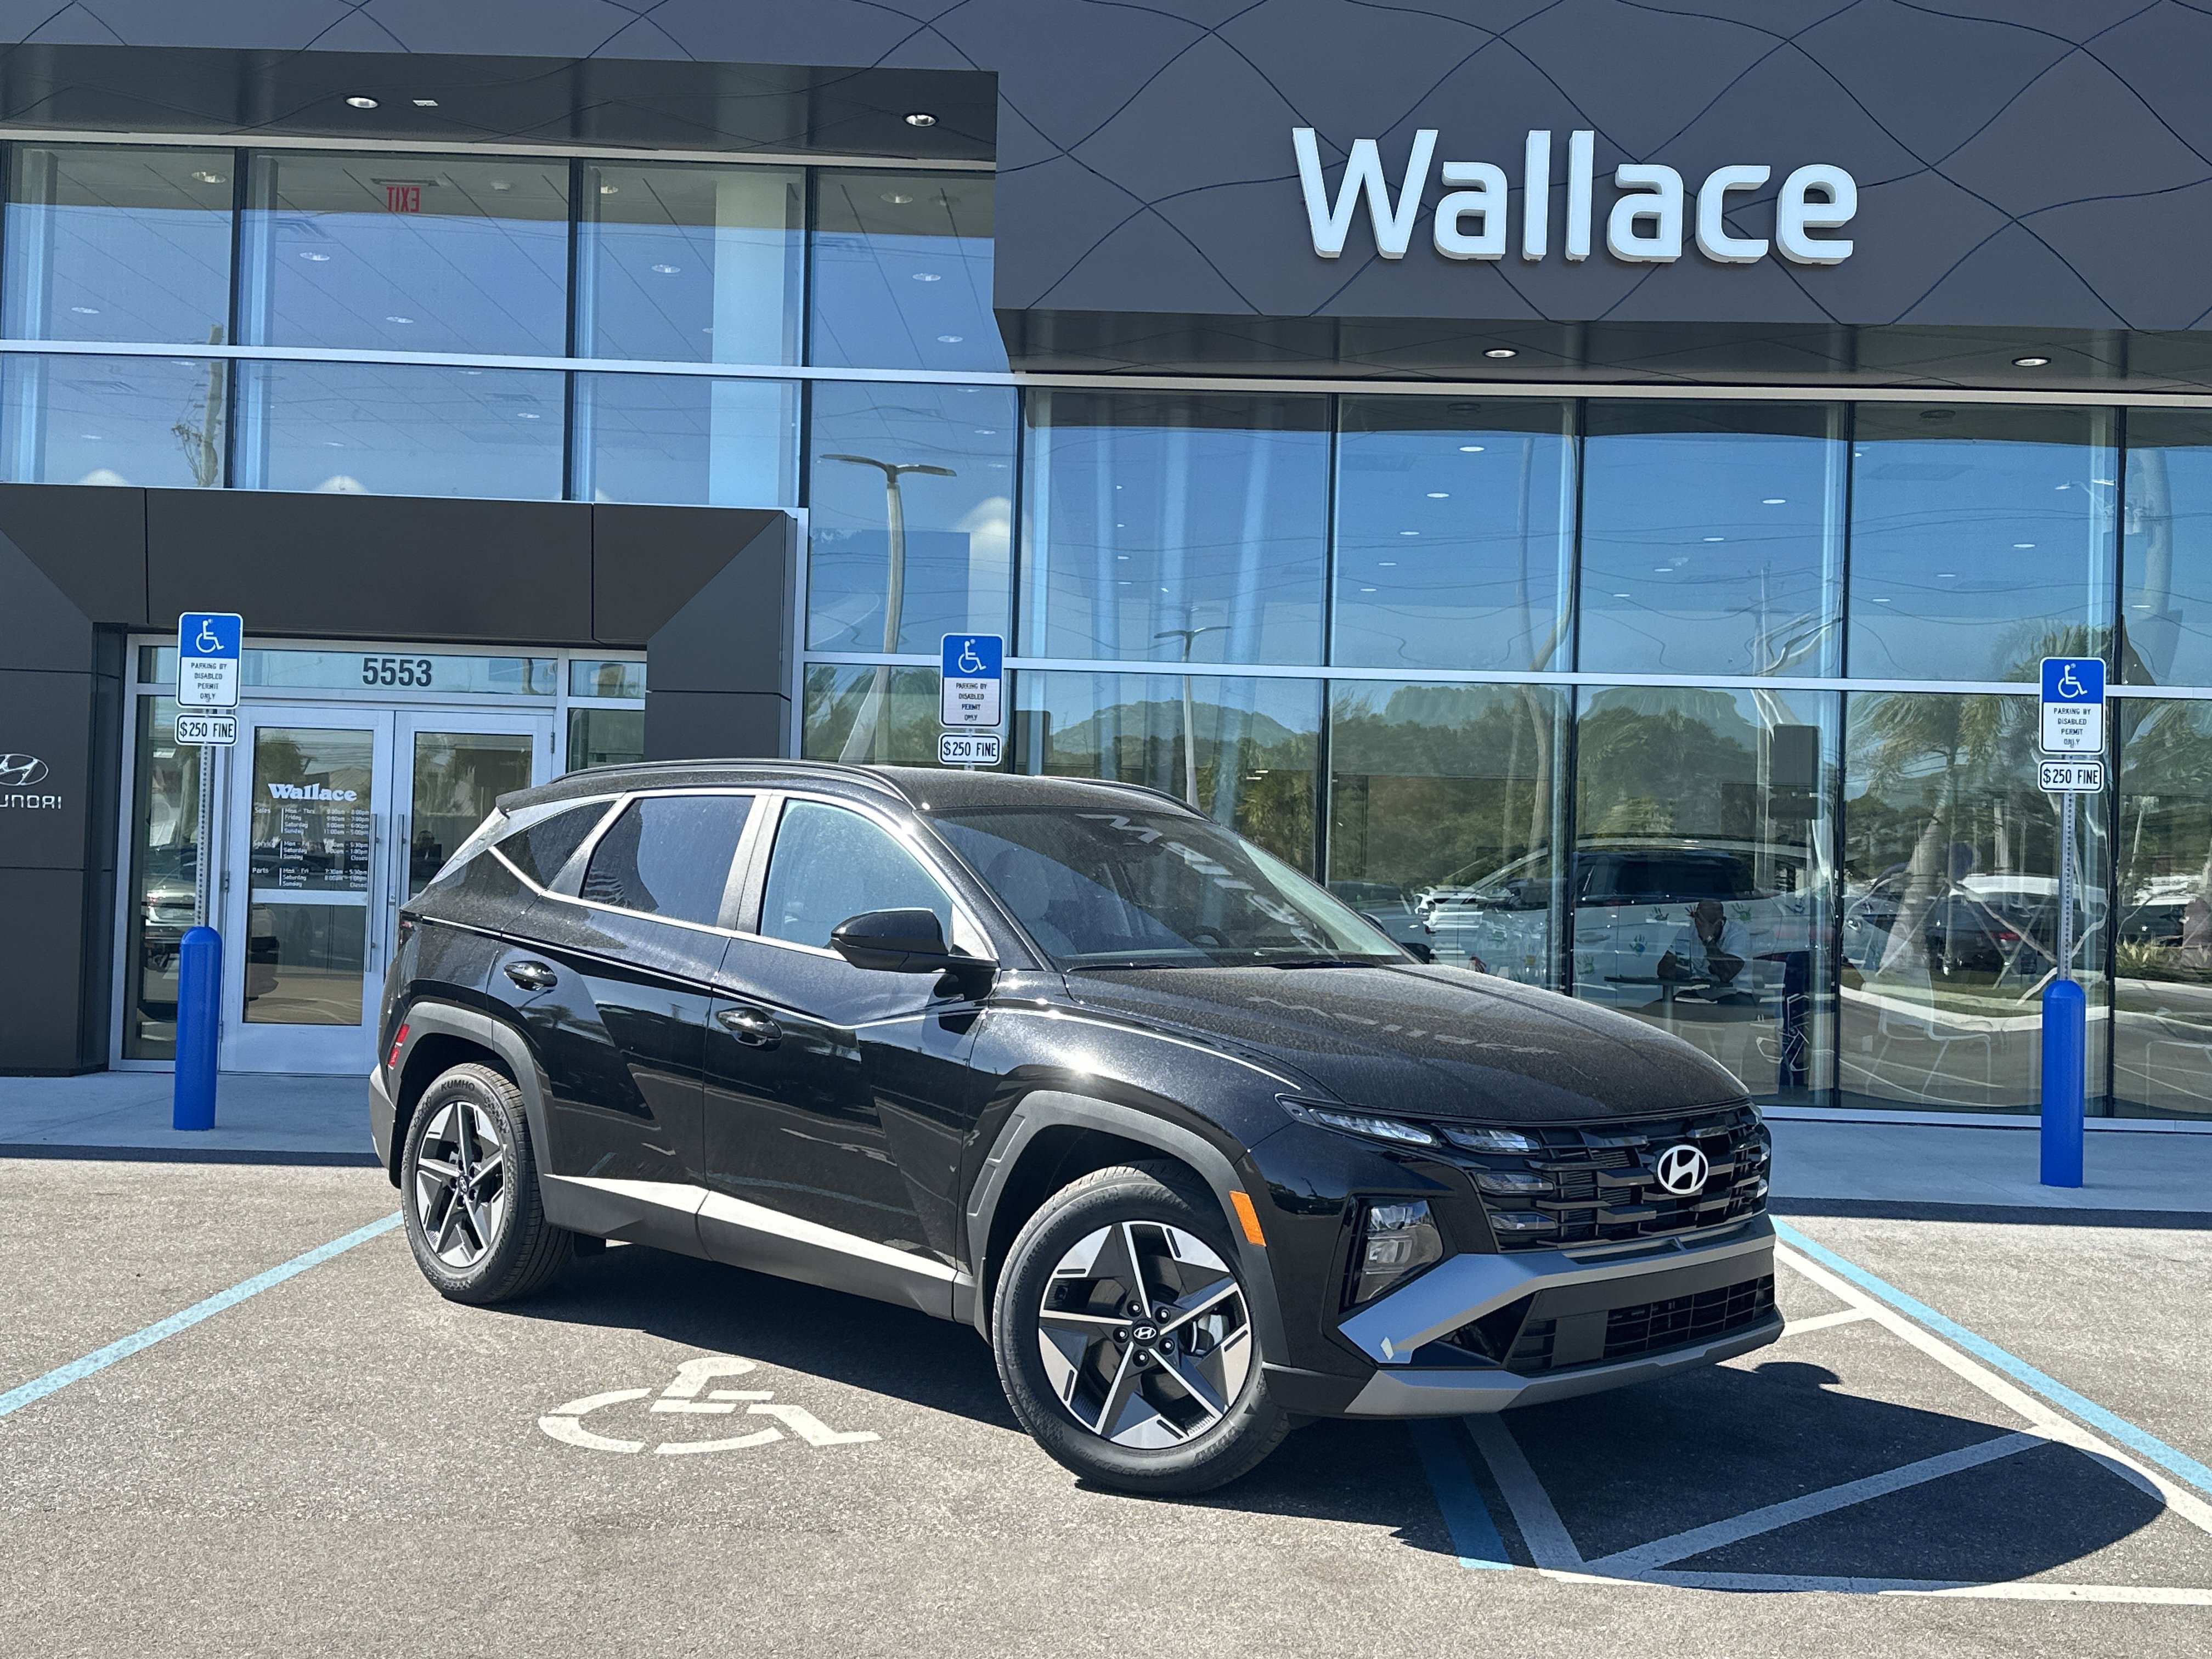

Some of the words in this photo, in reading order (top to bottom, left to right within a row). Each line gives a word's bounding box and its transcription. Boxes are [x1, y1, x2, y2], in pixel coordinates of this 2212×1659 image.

[1292, 127, 1858, 265] Wallace
[363, 658, 432, 687] 5553
[179, 720, 208, 738] $250
[213, 723, 234, 738] FINE
[943, 740, 971, 757] $250
[976, 742, 997, 757] FINE
[2042, 767, 2072, 785] $250
[2078, 769, 2098, 785] FINE
[267, 783, 357, 802] Wallace
[441, 1079, 475, 1092] KUMHO
[1011, 1265, 1029, 1307] 235/60
